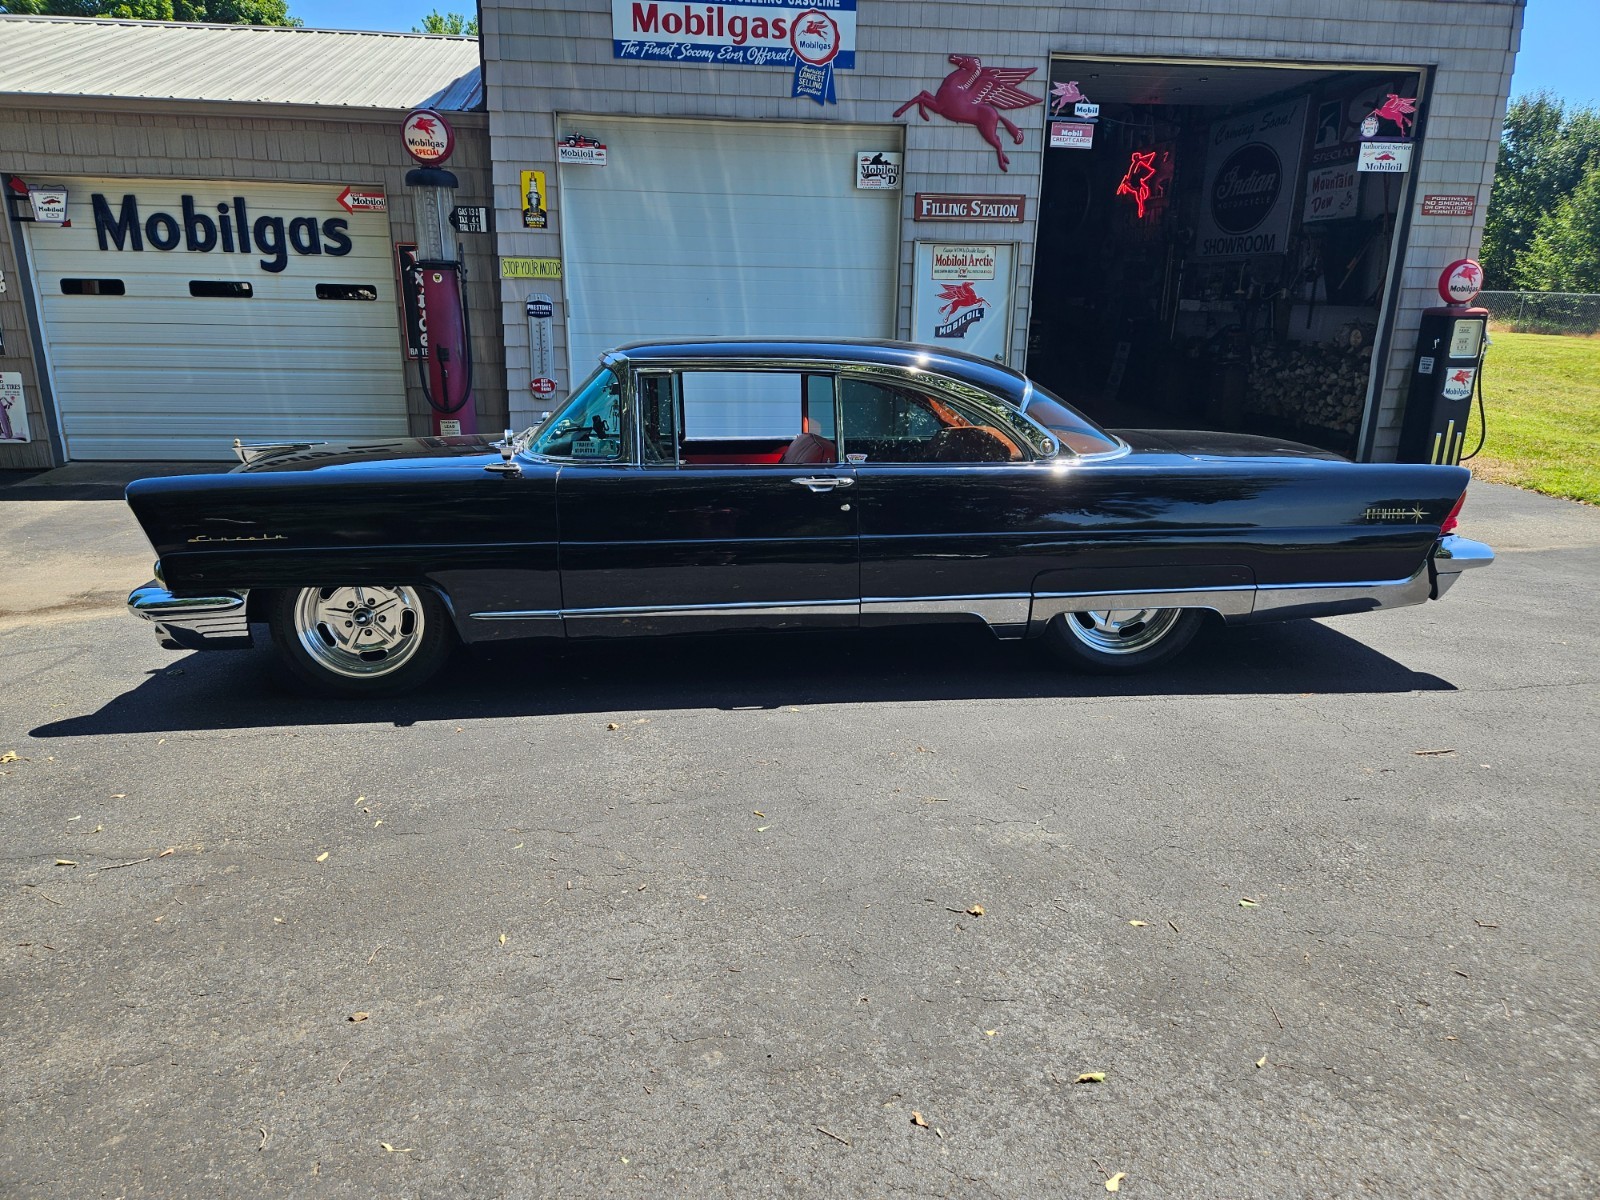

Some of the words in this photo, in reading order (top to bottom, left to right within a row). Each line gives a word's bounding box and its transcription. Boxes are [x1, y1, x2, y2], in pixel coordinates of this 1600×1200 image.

[632, 2, 787, 45] Mobilgas
[799, 40, 831, 51] Mobilgas
[620, 40, 640, 57] The
[641, 42, 679, 58] Finest
[677, 43, 715, 63] Socony
[717, 45, 744, 62] Ever
[747, 47, 794, 64] Offered!
[799, 71, 825, 82] LARGEST
[799, 78, 823, 90] SELLING
[1076, 106, 1098, 114] Mobil
[1214, 123, 1255, 145] Coming
[1259, 105, 1297, 131] Soon!
[408, 138, 445, 150] Mobilgas
[415, 148, 440, 156] SPECIAL
[560, 148, 594, 158] Mobiloil
[860, 164, 900, 175] Mobiloil
[1364, 162, 1403, 171] Mobiloil
[887, 175, 897, 185] D
[1216, 165, 1277, 199] Indian
[1313, 171, 1354, 194] Mountain
[352, 198, 385, 206] Mobiloil
[1312, 196, 1334, 214] Dew
[457, 207, 468, 216] GAS
[458, 215, 468, 223] TAX
[91, 193, 352, 273] Mobilgas
[1202, 233, 1276, 255] SHOWROOM
[934, 253, 967, 267] Mobiloil
[968, 253, 994, 267] Arctic
[503, 261, 519, 275] STOP
[520, 261, 540, 275] YOUR
[540, 261, 562, 275] MOTOR
[1449, 284, 1479, 295] Mobilgas
[527, 303, 552, 311] PRESTONE
[938, 309, 981, 336] MOBILOIL
[1445, 387, 1471, 397] Mobilgas
[1366, 508, 1406, 520] PREMIERE
[187, 533, 288, 543] Lincoln
